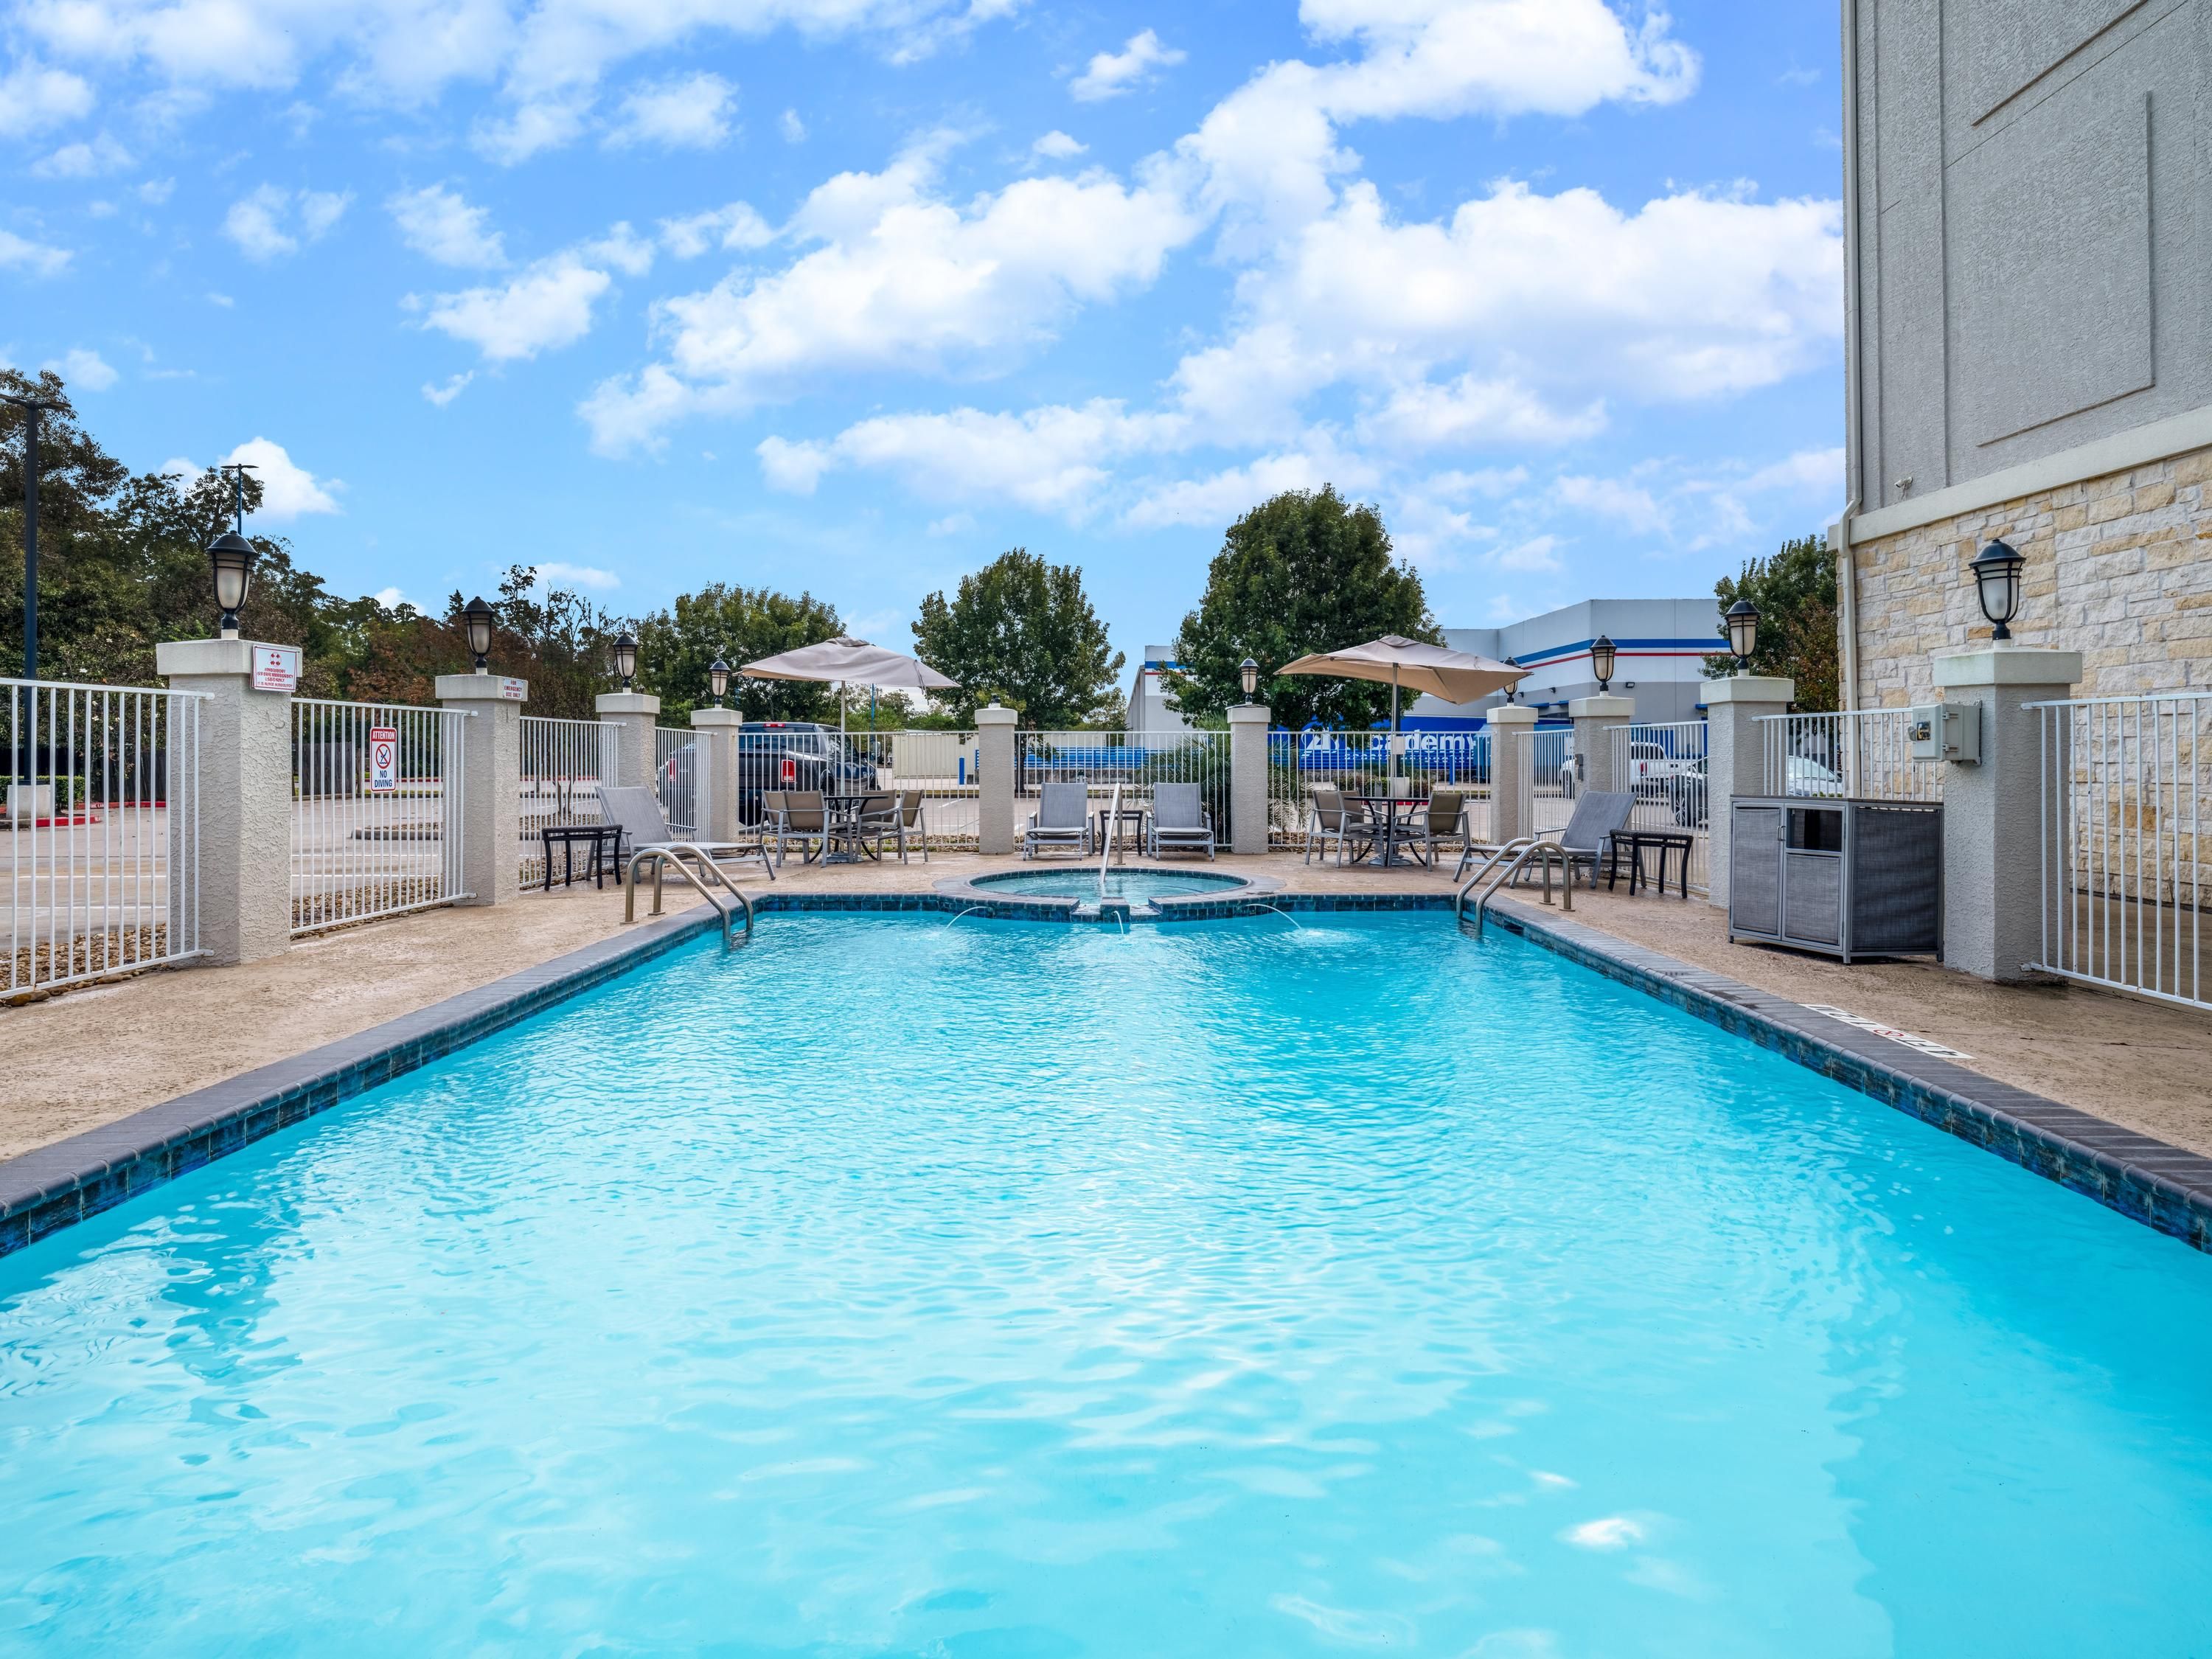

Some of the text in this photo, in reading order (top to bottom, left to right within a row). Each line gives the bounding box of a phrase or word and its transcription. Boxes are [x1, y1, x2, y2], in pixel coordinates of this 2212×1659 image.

[372, 731, 395, 740] ATTENTION
[380, 770, 387, 778] NO
[375, 779, 392, 787] DIVING
